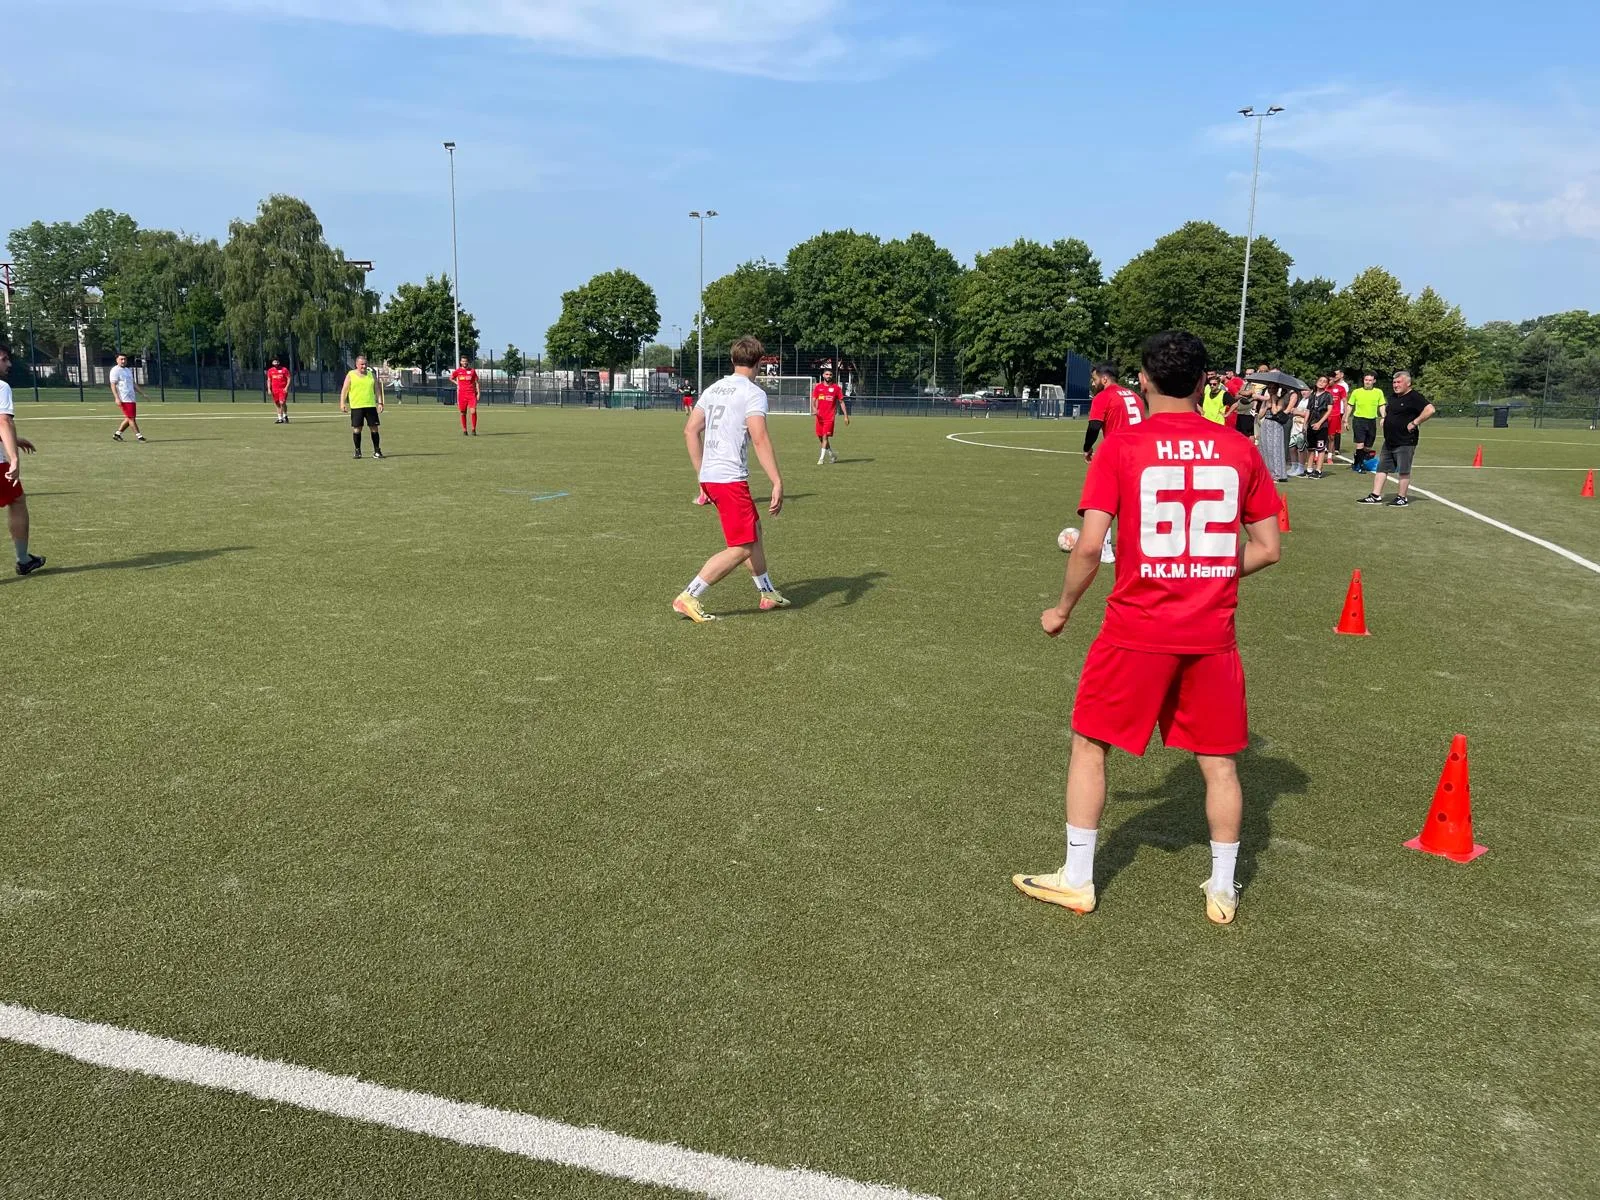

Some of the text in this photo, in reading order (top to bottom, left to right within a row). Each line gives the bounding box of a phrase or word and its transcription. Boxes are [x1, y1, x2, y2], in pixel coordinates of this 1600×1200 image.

[707, 404, 725, 430] 12
[1123, 397, 1142, 425] 5
[1156, 440, 1220, 460] H.B.V.
[1140, 465, 1240, 558] 62
[1140, 563, 1187, 578] A.K.M.
